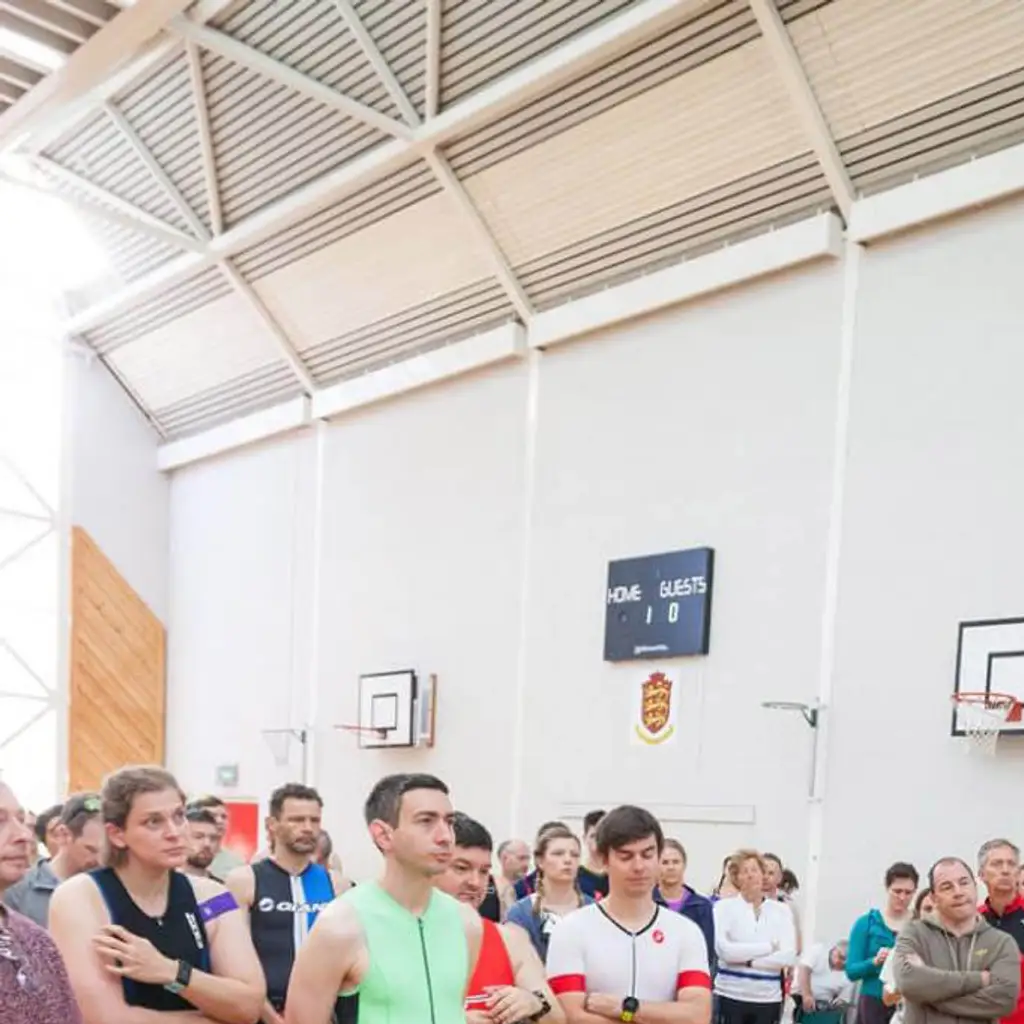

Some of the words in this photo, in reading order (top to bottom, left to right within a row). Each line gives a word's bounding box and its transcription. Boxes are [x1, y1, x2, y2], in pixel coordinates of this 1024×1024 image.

[607, 584, 642, 604] HOME
[660, 576, 707, 598] GUESTS
[646, 605, 652, 624] 1
[668, 602, 679, 623] 0
[276, 901, 325, 913] GIAN
